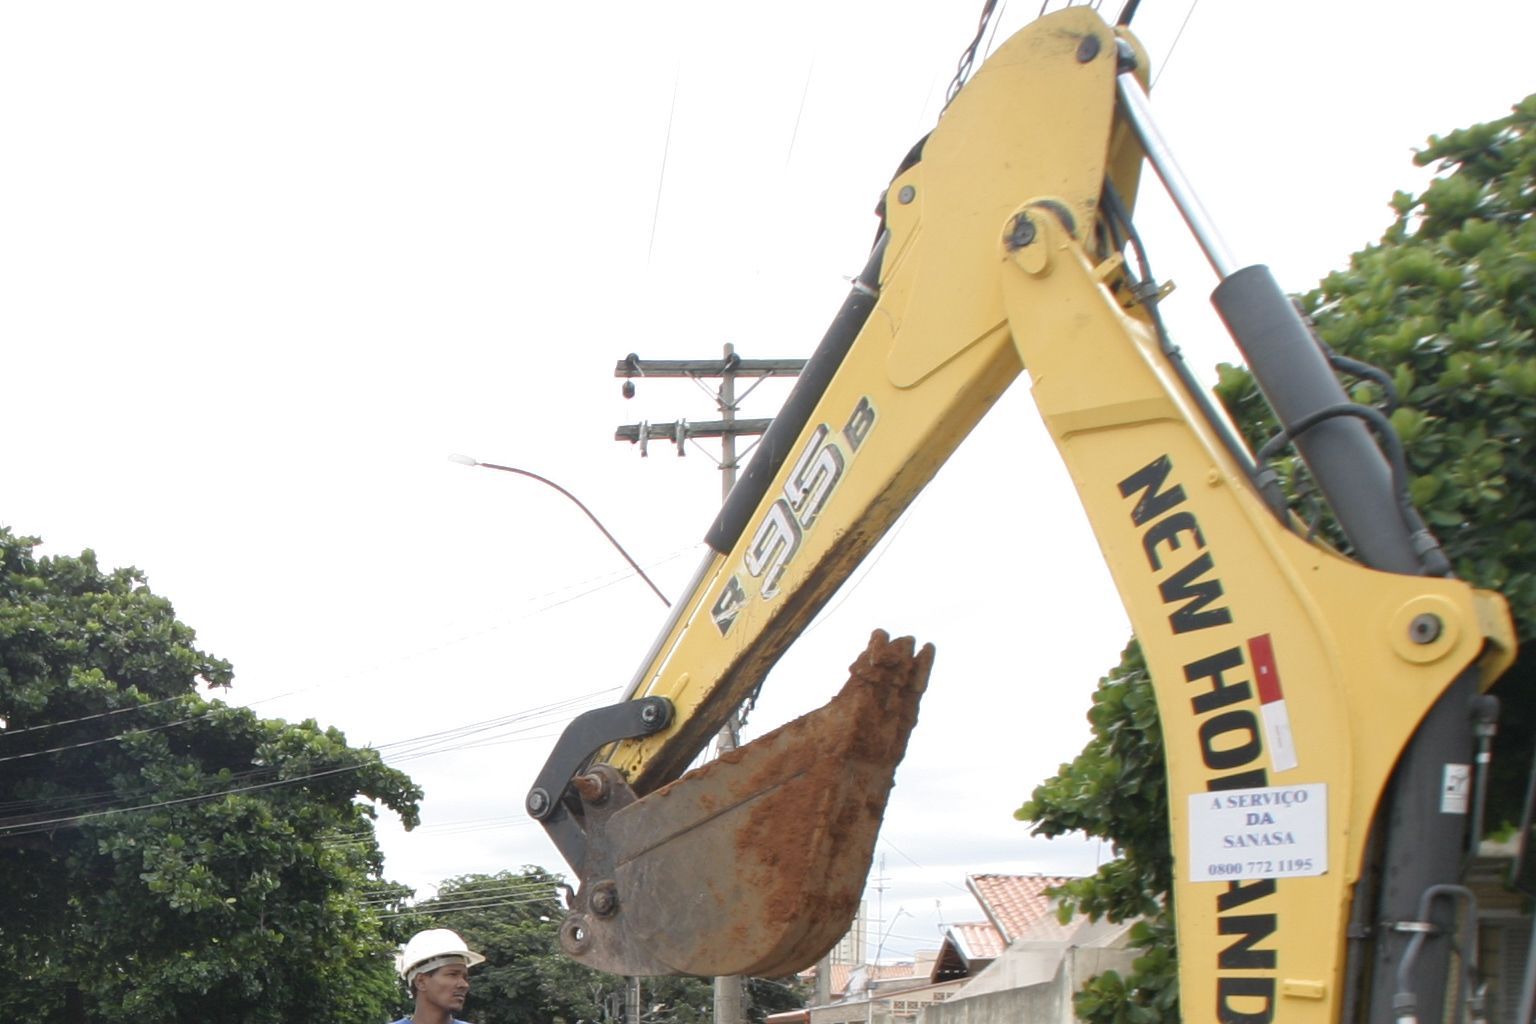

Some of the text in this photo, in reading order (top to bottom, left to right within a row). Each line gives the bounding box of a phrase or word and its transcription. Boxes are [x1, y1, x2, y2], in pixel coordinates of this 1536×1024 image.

[1117, 453, 1233, 635] NEW
[1210, 789, 1309, 810] A SERVIÇO
[1245, 812, 1275, 826] DA
[1223, 831, 1296, 849] SANASA
[1208, 858, 1313, 876] 0800 772 1195
